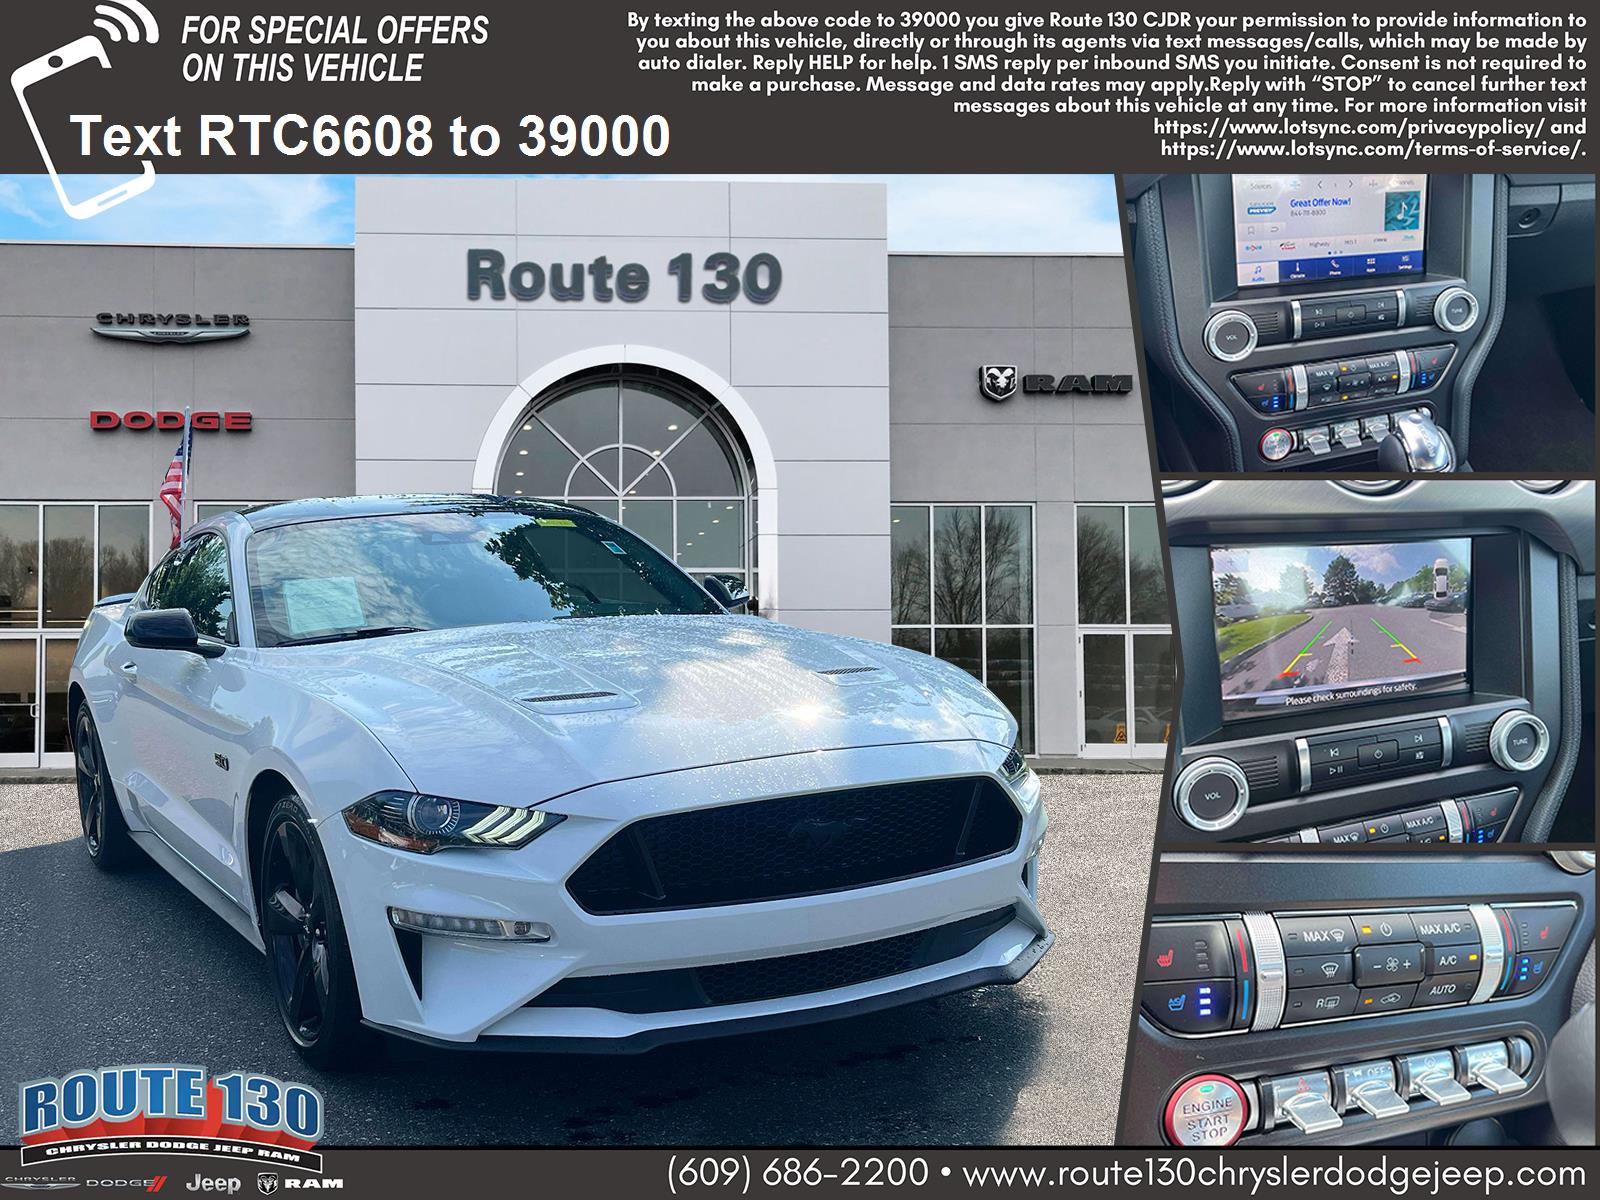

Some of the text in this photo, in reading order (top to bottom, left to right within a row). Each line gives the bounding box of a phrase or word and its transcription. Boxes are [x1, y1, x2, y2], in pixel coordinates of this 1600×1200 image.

[1290, 197, 1351, 208] Great Offer Now!
[467, 249, 783, 304] Route 130
[96, 312, 250, 326] CHRYSLER
[1022, 374, 1133, 395] RAM
[90, 411, 252, 431] DODGE
[1285, 682, 1418, 706] Please check surroundings for safety.
[1204, 791, 1221, 800] VOL
[1406, 816, 1434, 829] MAX A/C
[1420, 922, 1461, 935] MAX A/C
[1303, 931, 1330, 943] MAX
[1439, 956, 1457, 966] A/C
[1430, 984, 1456, 995] AUTO
[1183, 1096, 1233, 1115] ENGINE
[1187, 1113, 1230, 1131] START
[1192, 1127, 1228, 1142] STOP
